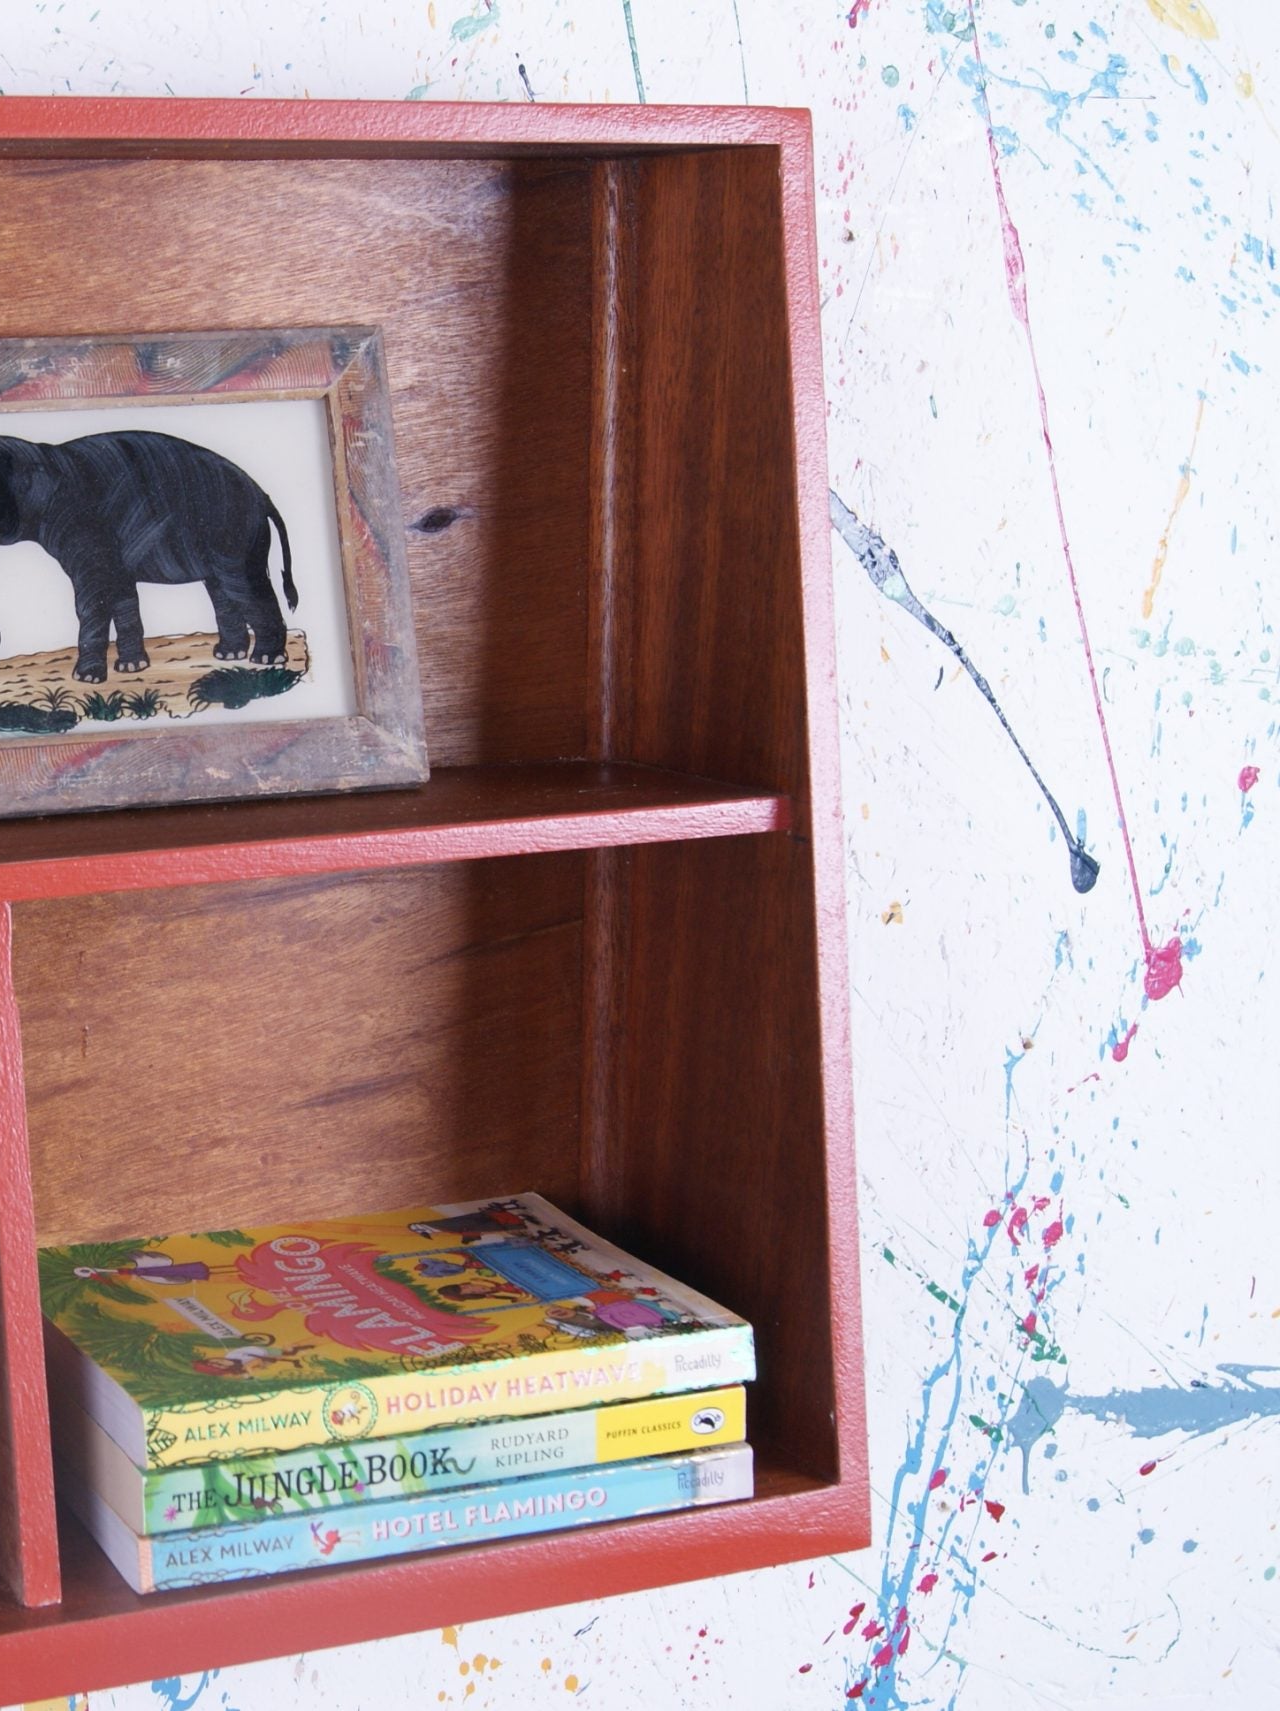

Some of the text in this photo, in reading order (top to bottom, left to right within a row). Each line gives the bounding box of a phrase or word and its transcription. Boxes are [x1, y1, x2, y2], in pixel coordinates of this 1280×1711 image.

[270, 1236, 464, 1357] FLAMINGO
[338, 1264, 389, 1296] HEATWAVE
[174, 1298, 234, 1336] ALEX MILWAY
[184, 1352, 721, 1443] ALEX MILWAY HOLIDAY HEATWAVE Piccadilly
[490, 1428, 569, 1450] RUDYARD
[606, 1420, 682, 1439] PUFFIN CLASSICS
[495, 1446, 565, 1468] KIPLING
[172, 1446, 470, 1513] THE JUNGLE BOOK
[166, 1471, 725, 1568] ALEX MILWAY HOTEL FLAMINGO Piccadilly
